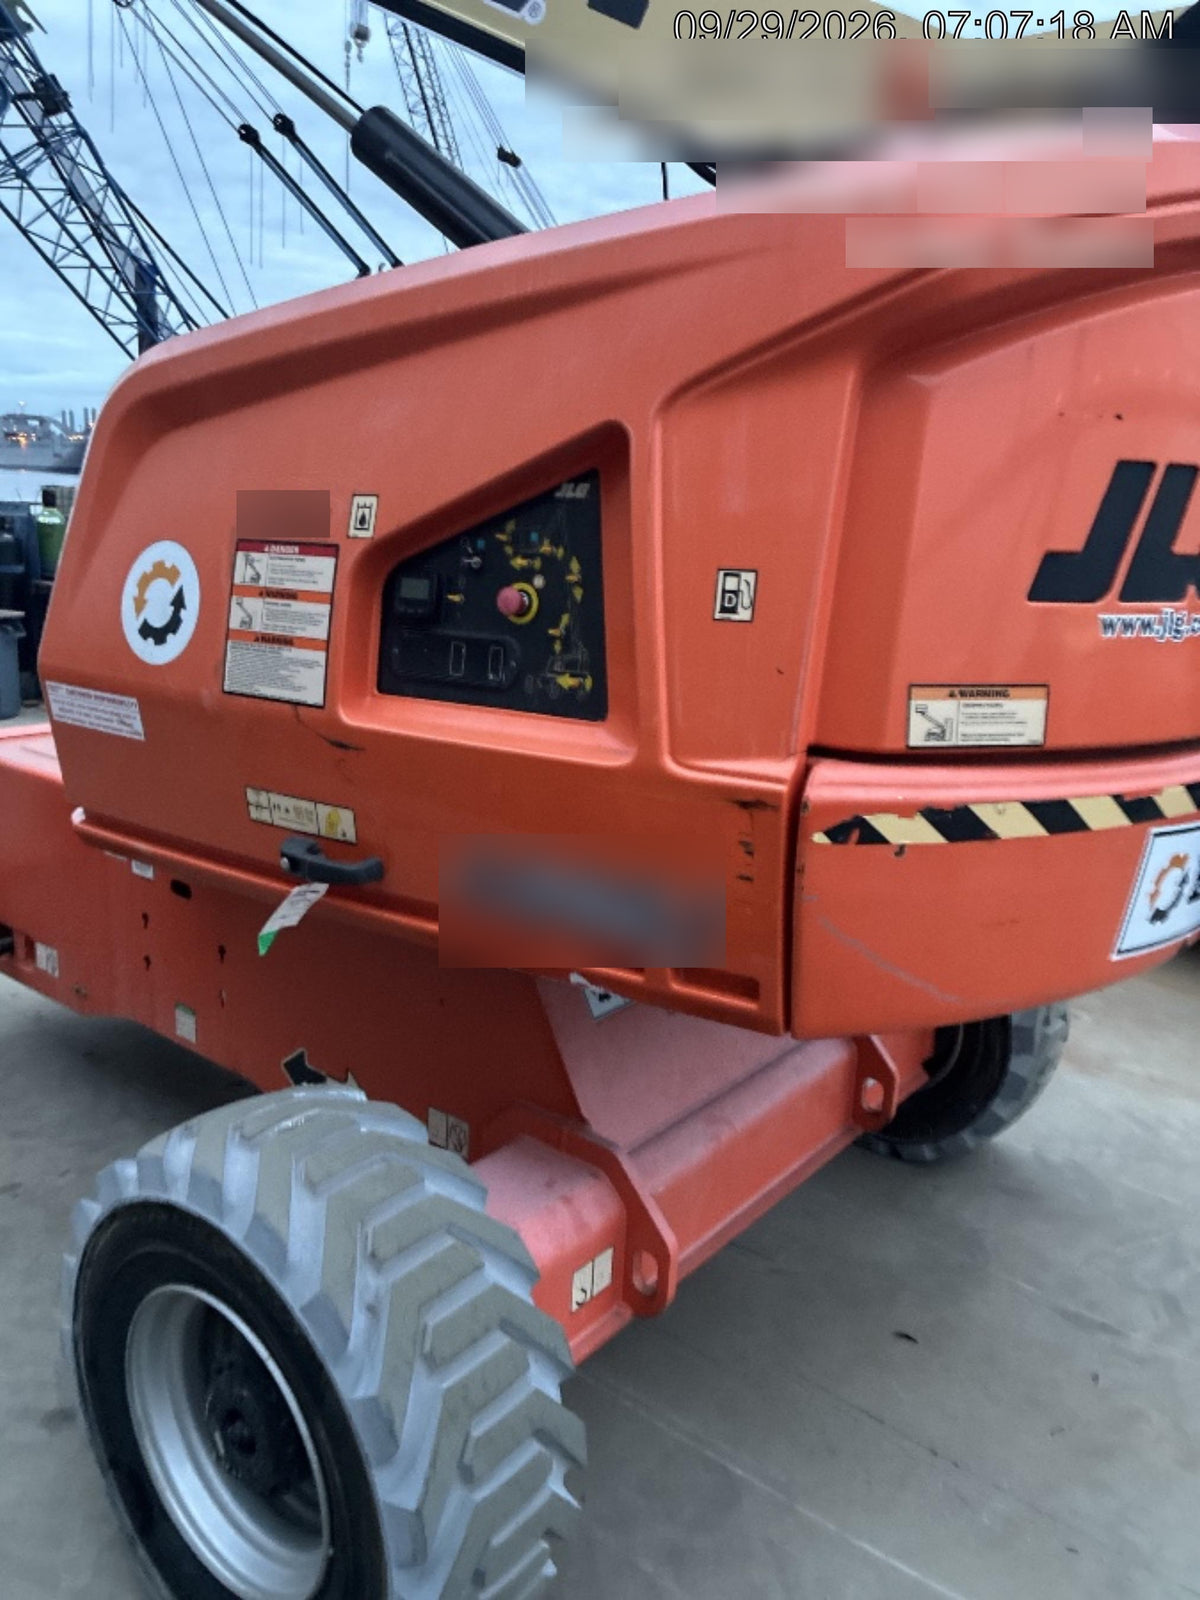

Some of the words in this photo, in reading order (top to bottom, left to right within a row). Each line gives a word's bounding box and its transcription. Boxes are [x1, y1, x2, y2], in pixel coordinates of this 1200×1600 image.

[1028, 460, 1200, 602] JL
[724, 593, 737, 607] D
[958, 689, 1010, 698] WARNING
